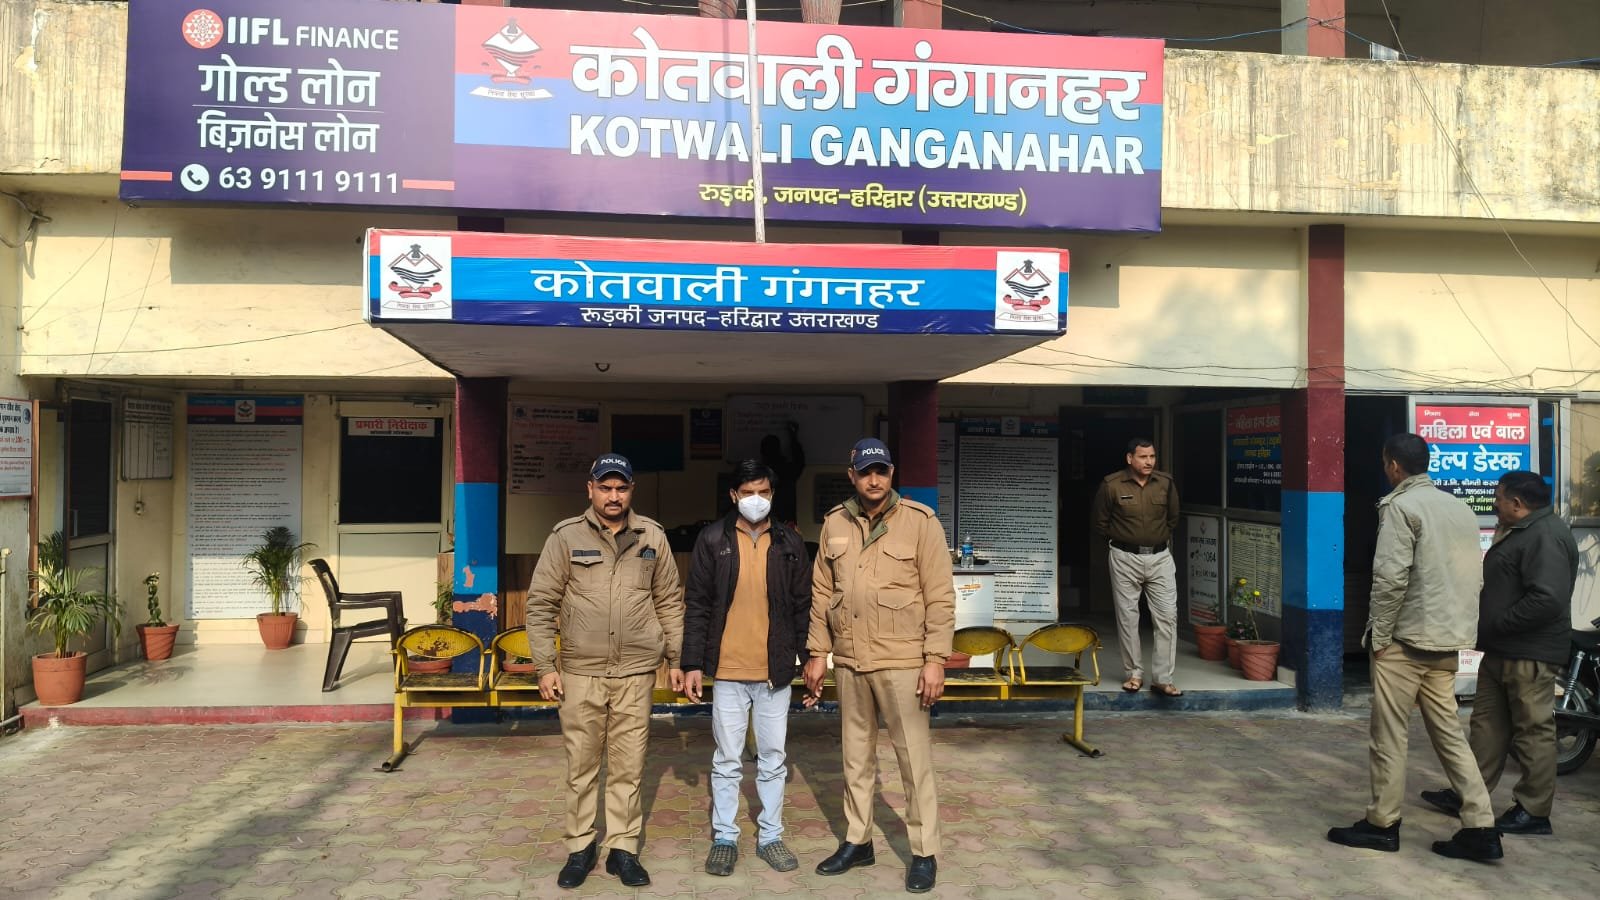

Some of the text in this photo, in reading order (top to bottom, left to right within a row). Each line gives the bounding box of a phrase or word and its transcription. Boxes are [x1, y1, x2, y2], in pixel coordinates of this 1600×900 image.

[227, 17, 399, 50] IIFL FINANCE
[198, 54, 381, 107] गोल्ड लोन
[568, 26, 1148, 126] कोतवाली गंगानहर
[197, 110, 380, 154] बिज़नेस लोन
[569, 114, 1145, 175] KOTWALI GANGANAHAR
[218, 166, 398, 194] 63 9111 9111
[918, 185, 1027, 216] (उत्तराखण्ड)
[530, 260, 926, 309] कोतवाली गंगनहर
[789, 310, 880, 330] उत्तराखण्ड
[1419, 418, 1527, 441] महिला एवं बाल
[601, 458, 627, 467] POLICE
[862, 447, 885, 457] POLICE
[1472, 444, 1523, 473] डेस्क
